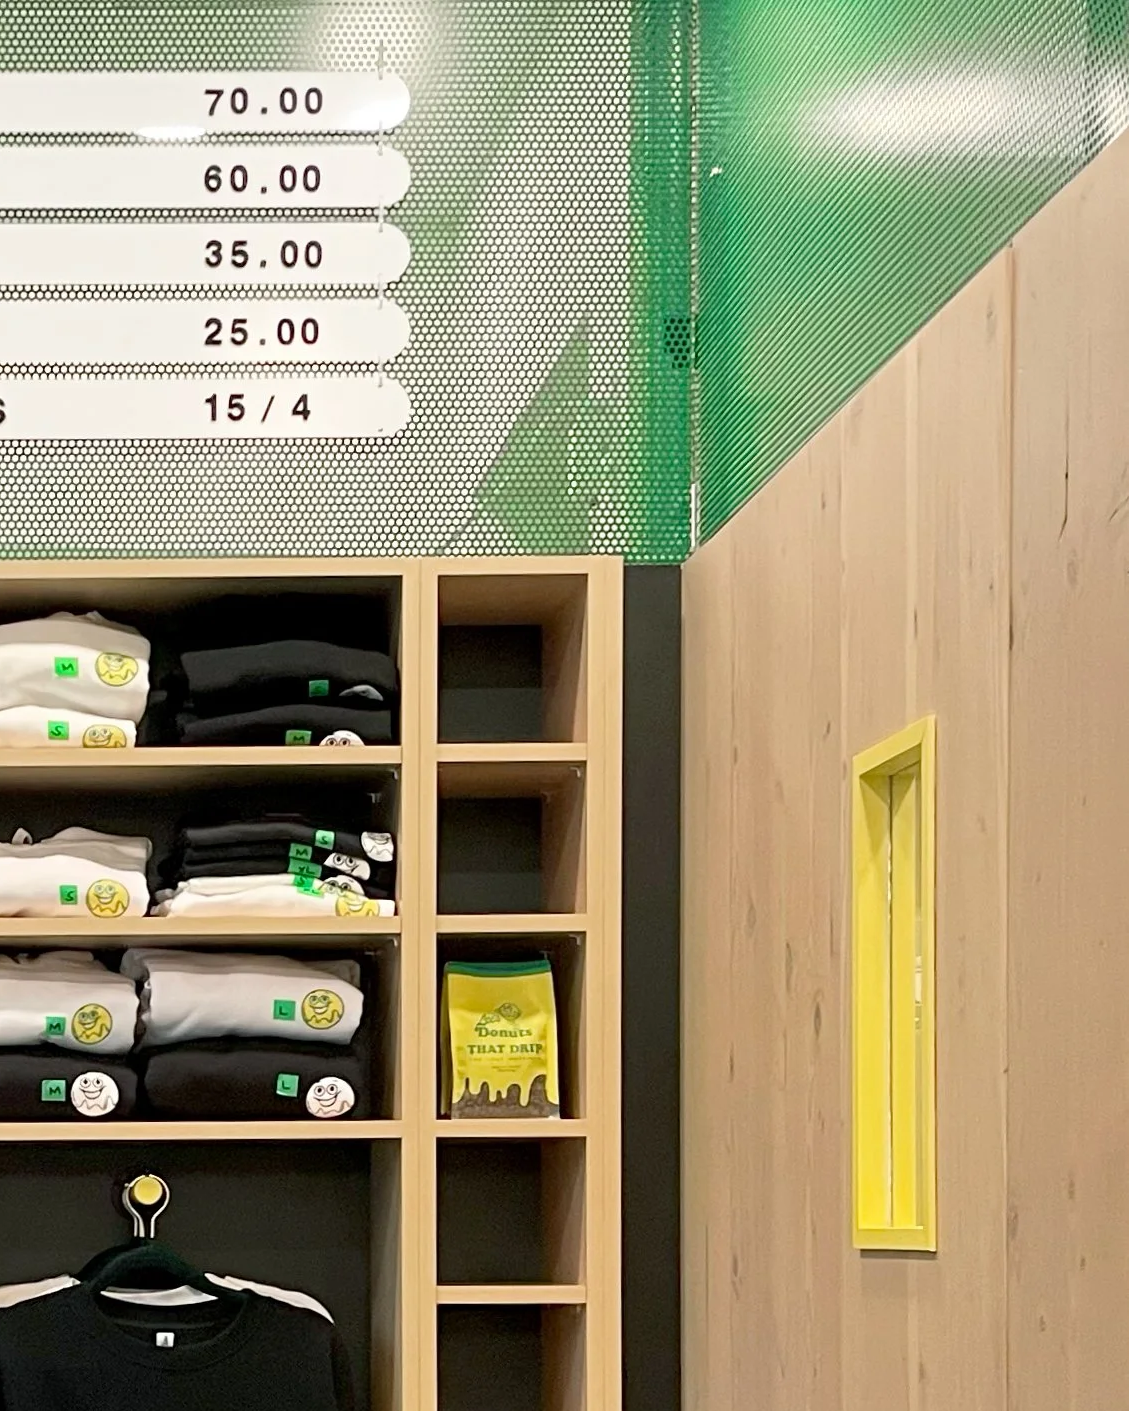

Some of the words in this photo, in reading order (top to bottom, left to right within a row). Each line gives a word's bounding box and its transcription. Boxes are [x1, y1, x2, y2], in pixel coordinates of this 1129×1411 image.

[204, 87, 324, 116] 70.00
[204, 164, 322, 194] 60.00
[205, 239, 324, 269] 35.00
[204, 317, 320, 346] 25.00
[205, 393, 246, 422] 15
[291, 392, 312, 422] 4
[475, 1026, 532, 1038] Donuts
[467, 1044, 506, 1055] THAT
[509, 1043, 544, 1055] DRIP
